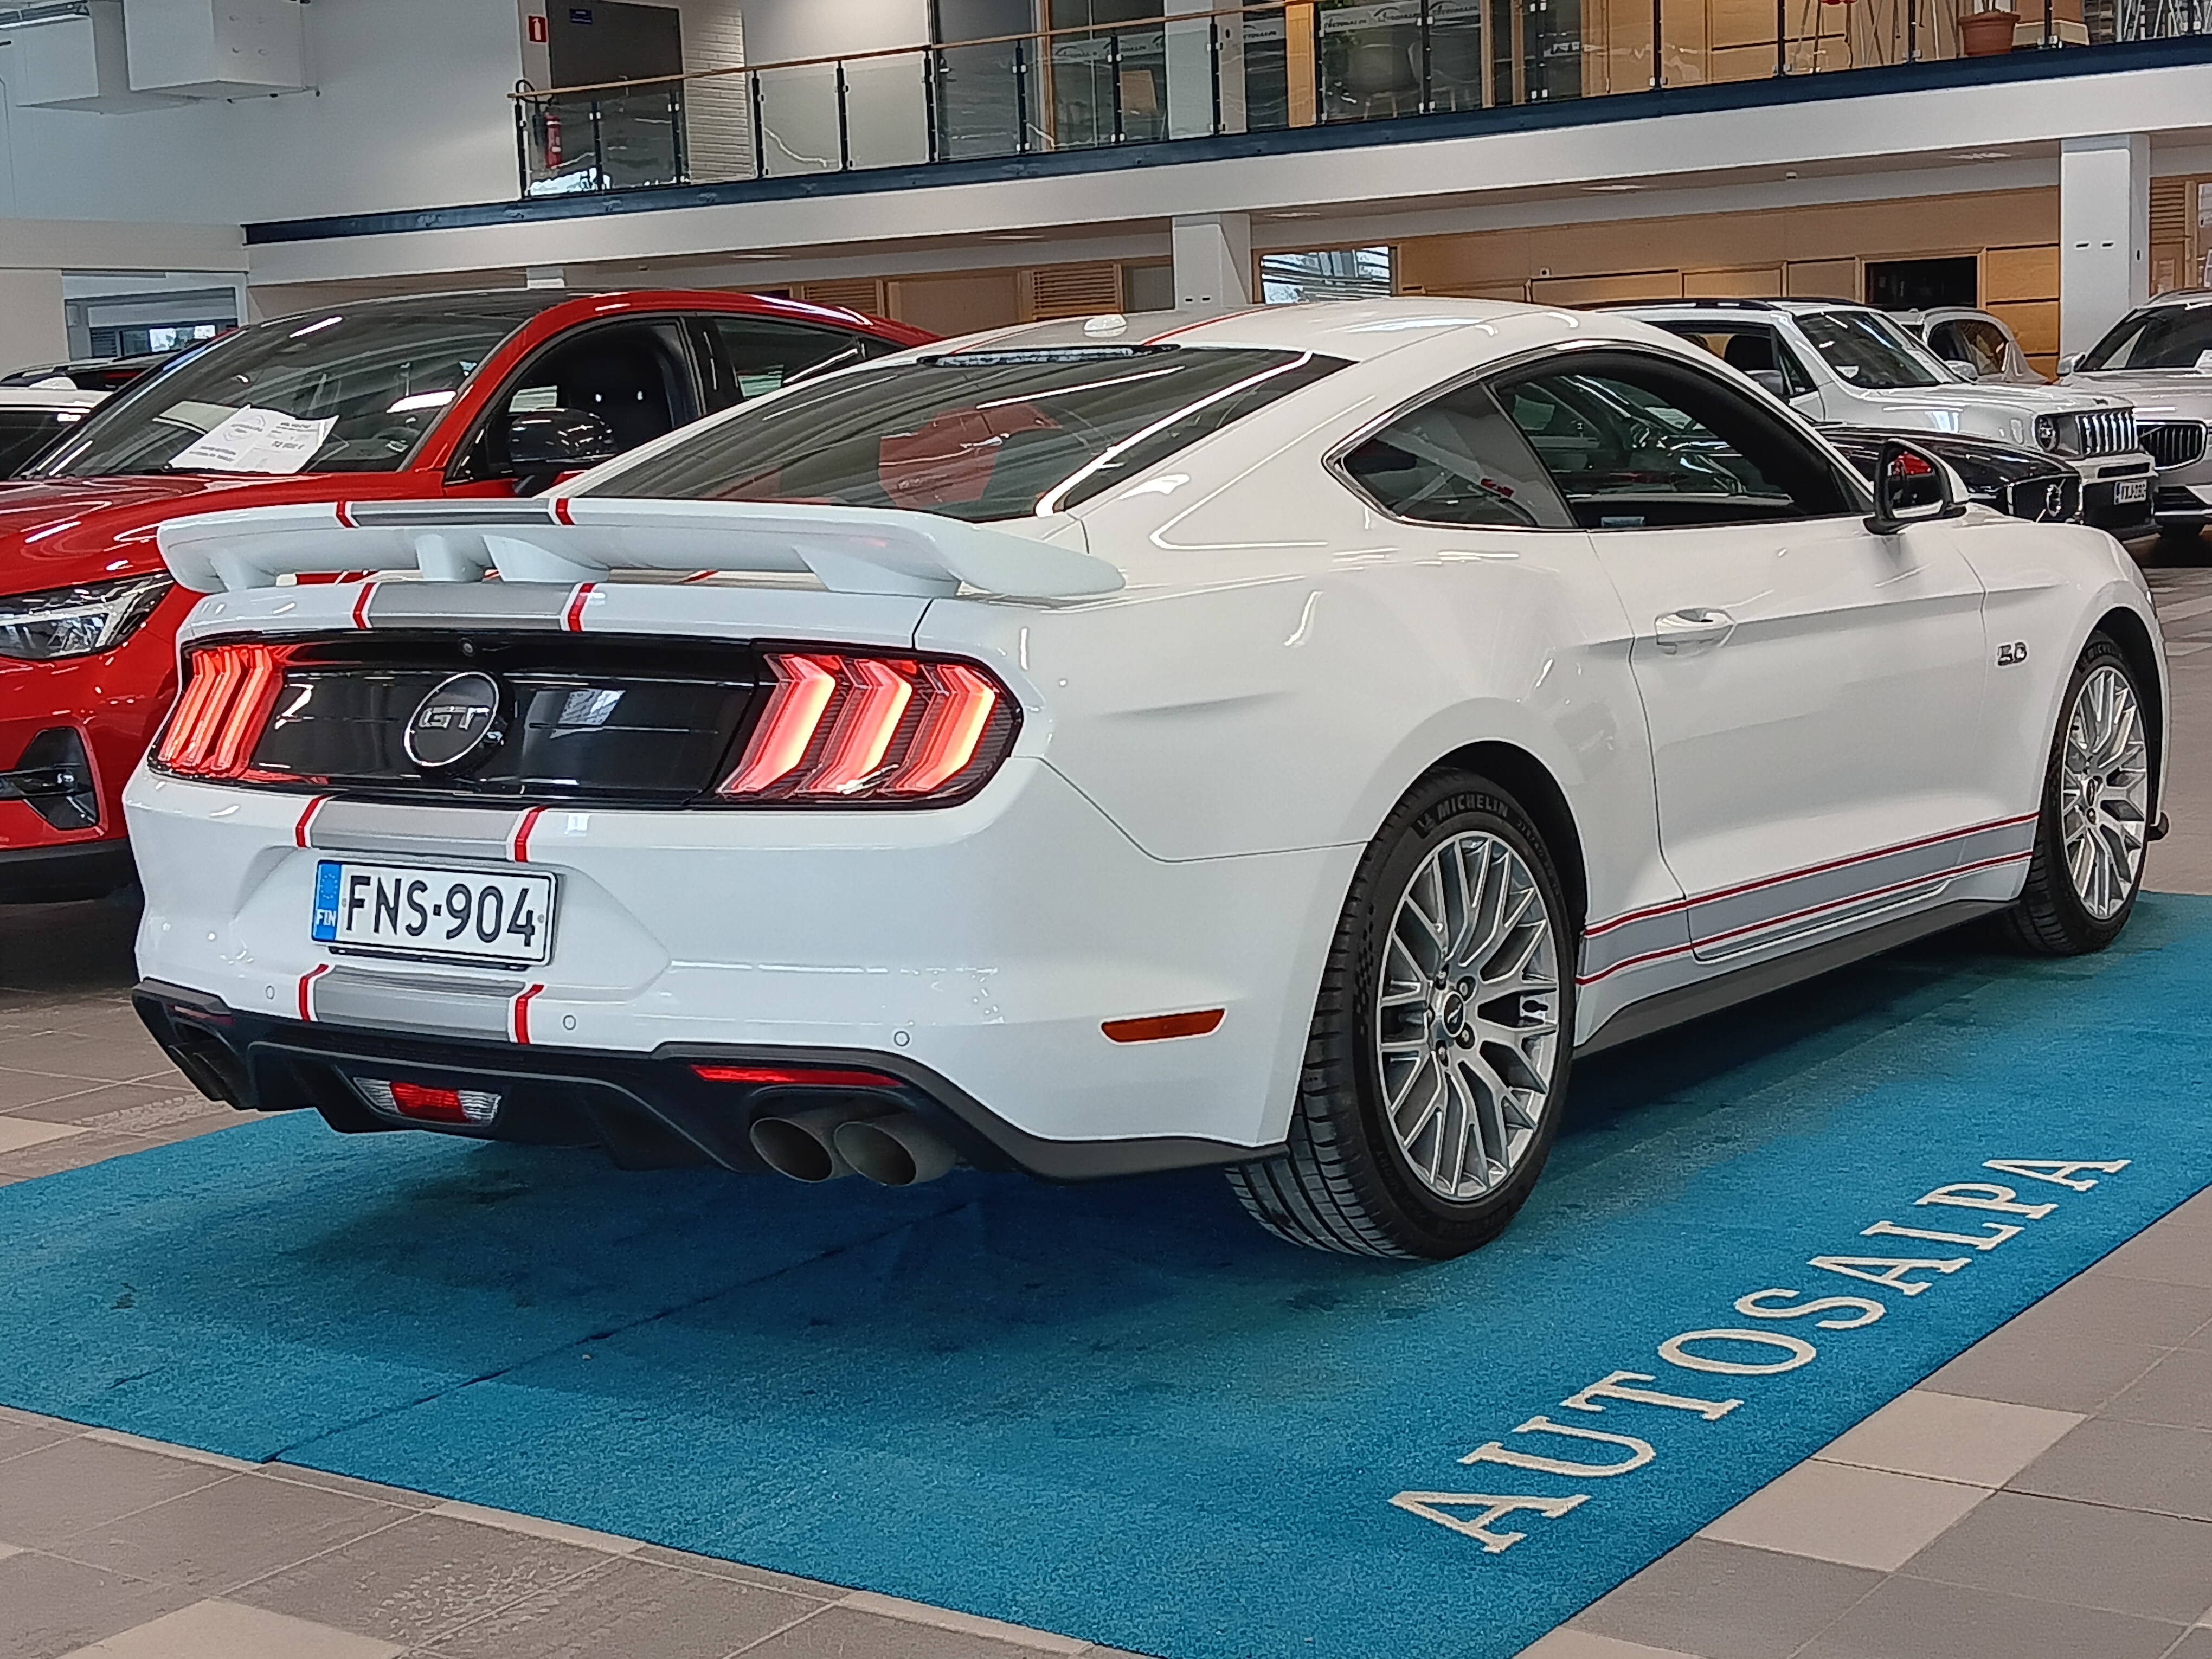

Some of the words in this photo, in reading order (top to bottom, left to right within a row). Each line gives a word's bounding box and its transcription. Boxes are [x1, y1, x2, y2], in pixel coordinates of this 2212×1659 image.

[418, 706, 490, 730] GT
[1437, 794, 1509, 821] MICHELIN
[316, 909, 336, 927] FIN
[1388, 1158, 2132, 1553] AUTOSALPA
